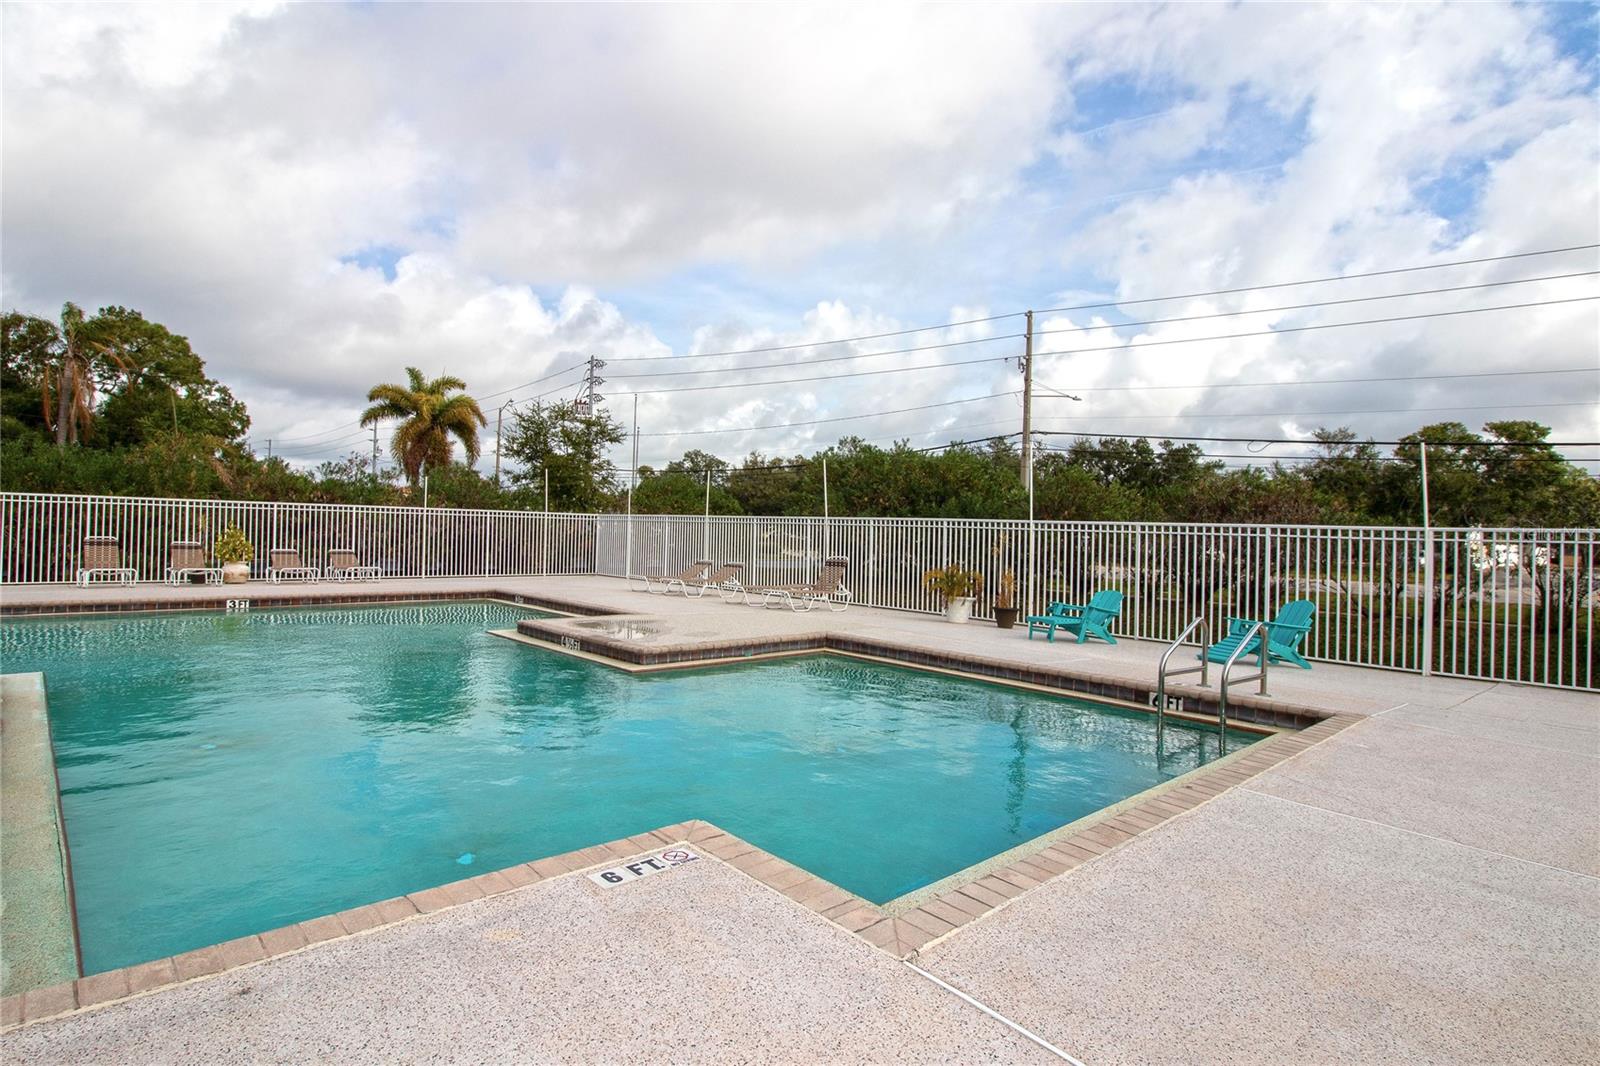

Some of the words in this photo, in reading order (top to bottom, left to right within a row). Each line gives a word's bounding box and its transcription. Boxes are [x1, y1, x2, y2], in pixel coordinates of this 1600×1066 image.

[229, 600, 236, 608] 3
[238, 600, 249, 608] FT
[1167, 694, 1182, 710] FT
[600, 872, 623, 883] 6
[626, 859, 665, 875] FT.
